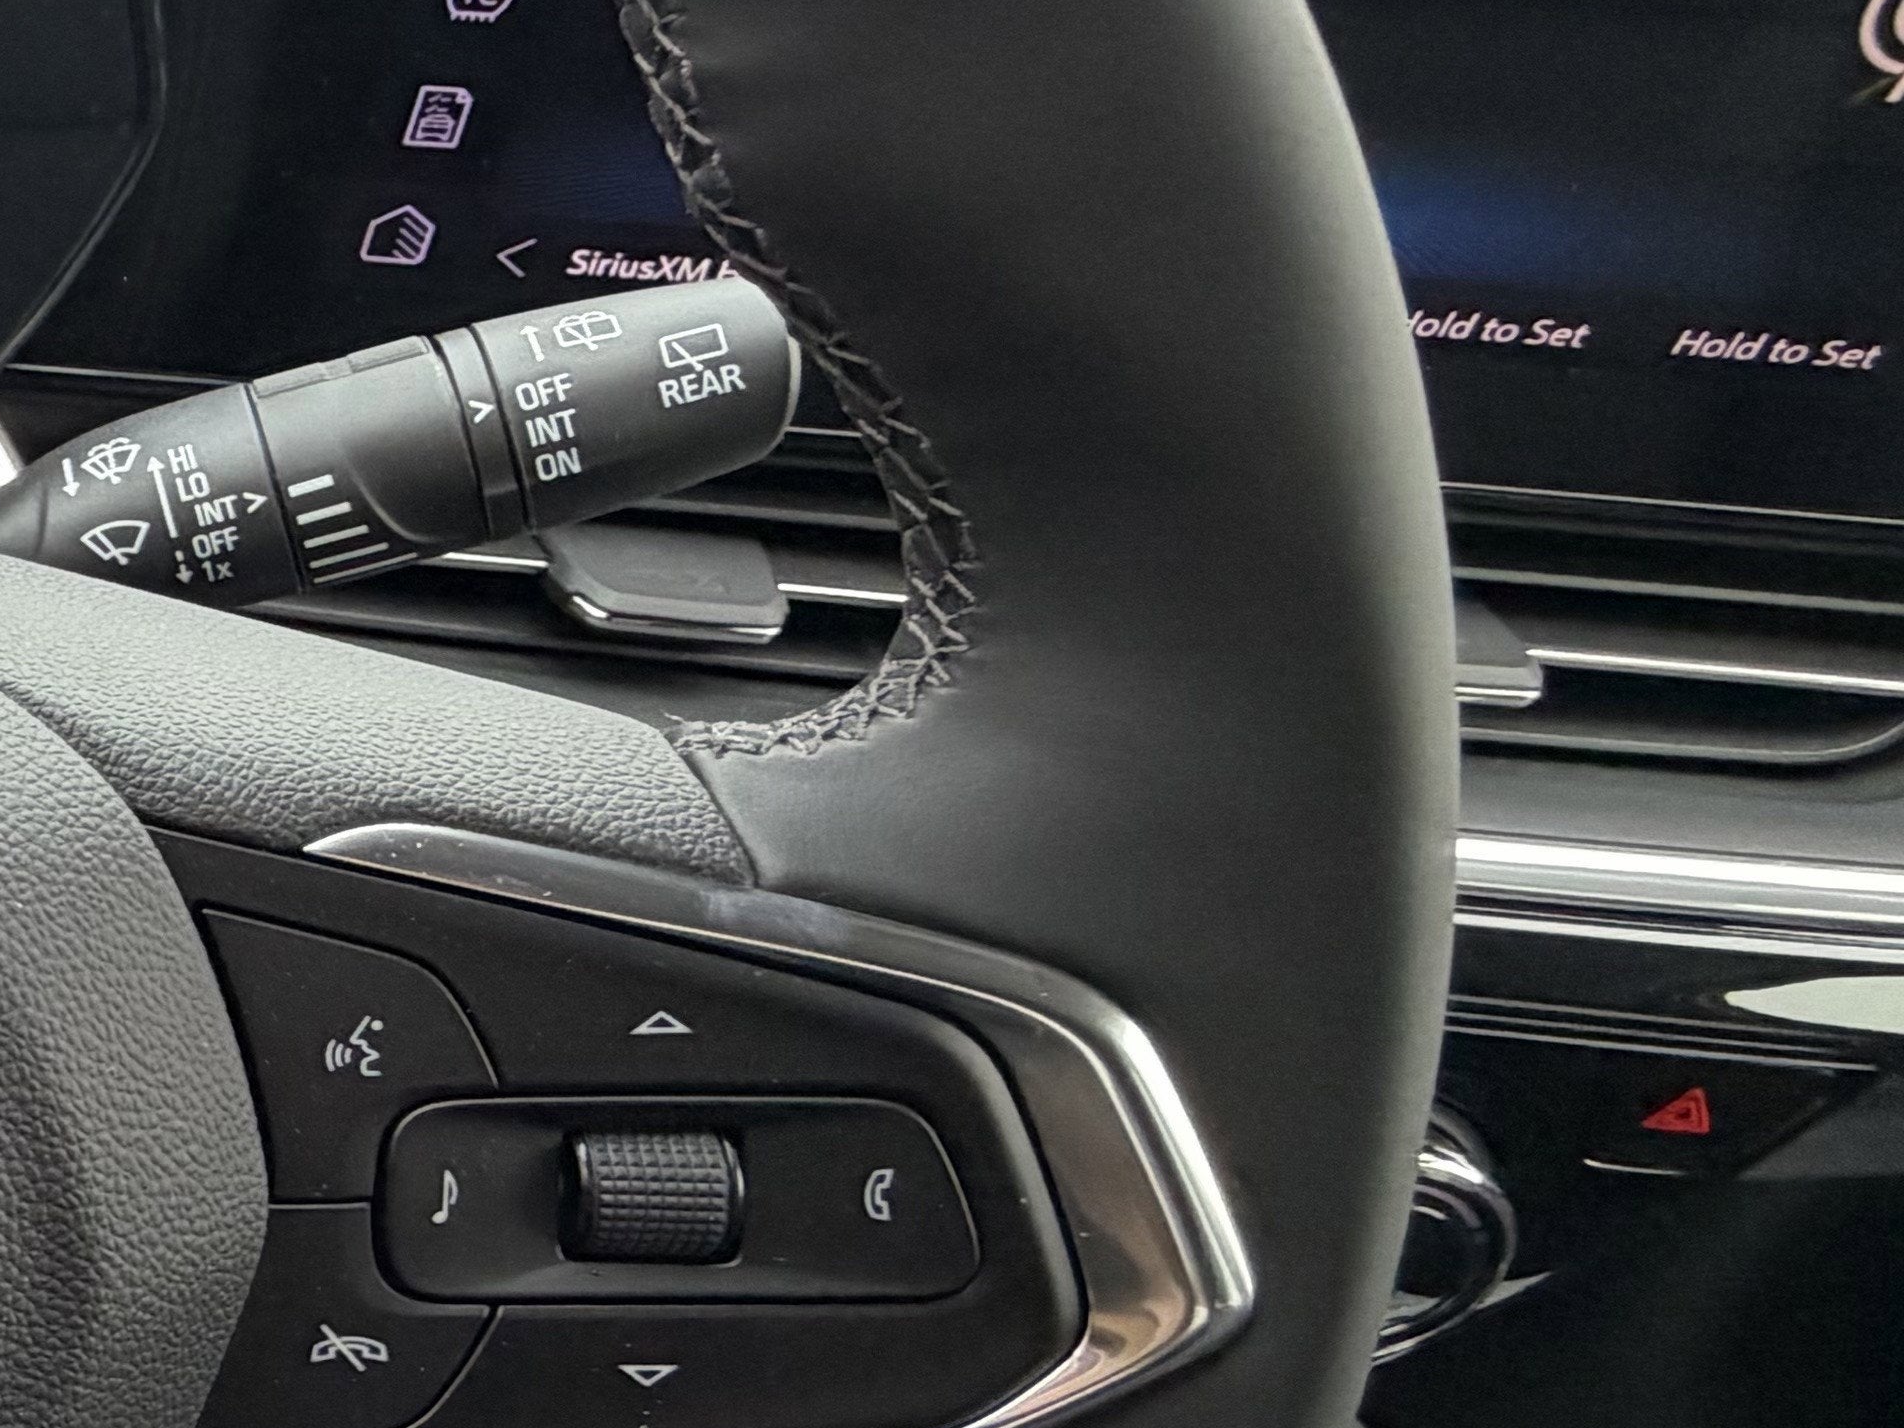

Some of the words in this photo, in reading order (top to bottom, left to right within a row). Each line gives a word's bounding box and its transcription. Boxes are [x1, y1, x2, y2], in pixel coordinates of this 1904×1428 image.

[566, 248, 712, 282] SiriusXM
[1480, 316, 1520, 343] to
[1523, 317, 1591, 349] Set
[1670, 328, 1767, 361] Hold
[1767, 337, 1810, 364] to
[1811, 339, 1882, 370] Set
[515, 373, 572, 411] OFF
[658, 364, 746, 408] REAR
[525, 408, 576, 448] INT
[166, 444, 198, 474] HI
[535, 447, 582, 481] ON
[175, 472, 211, 502] LO
[194, 494, 238, 527] INT
[192, 526, 240, 559] OFF
[201, 560, 234, 582] 1x
